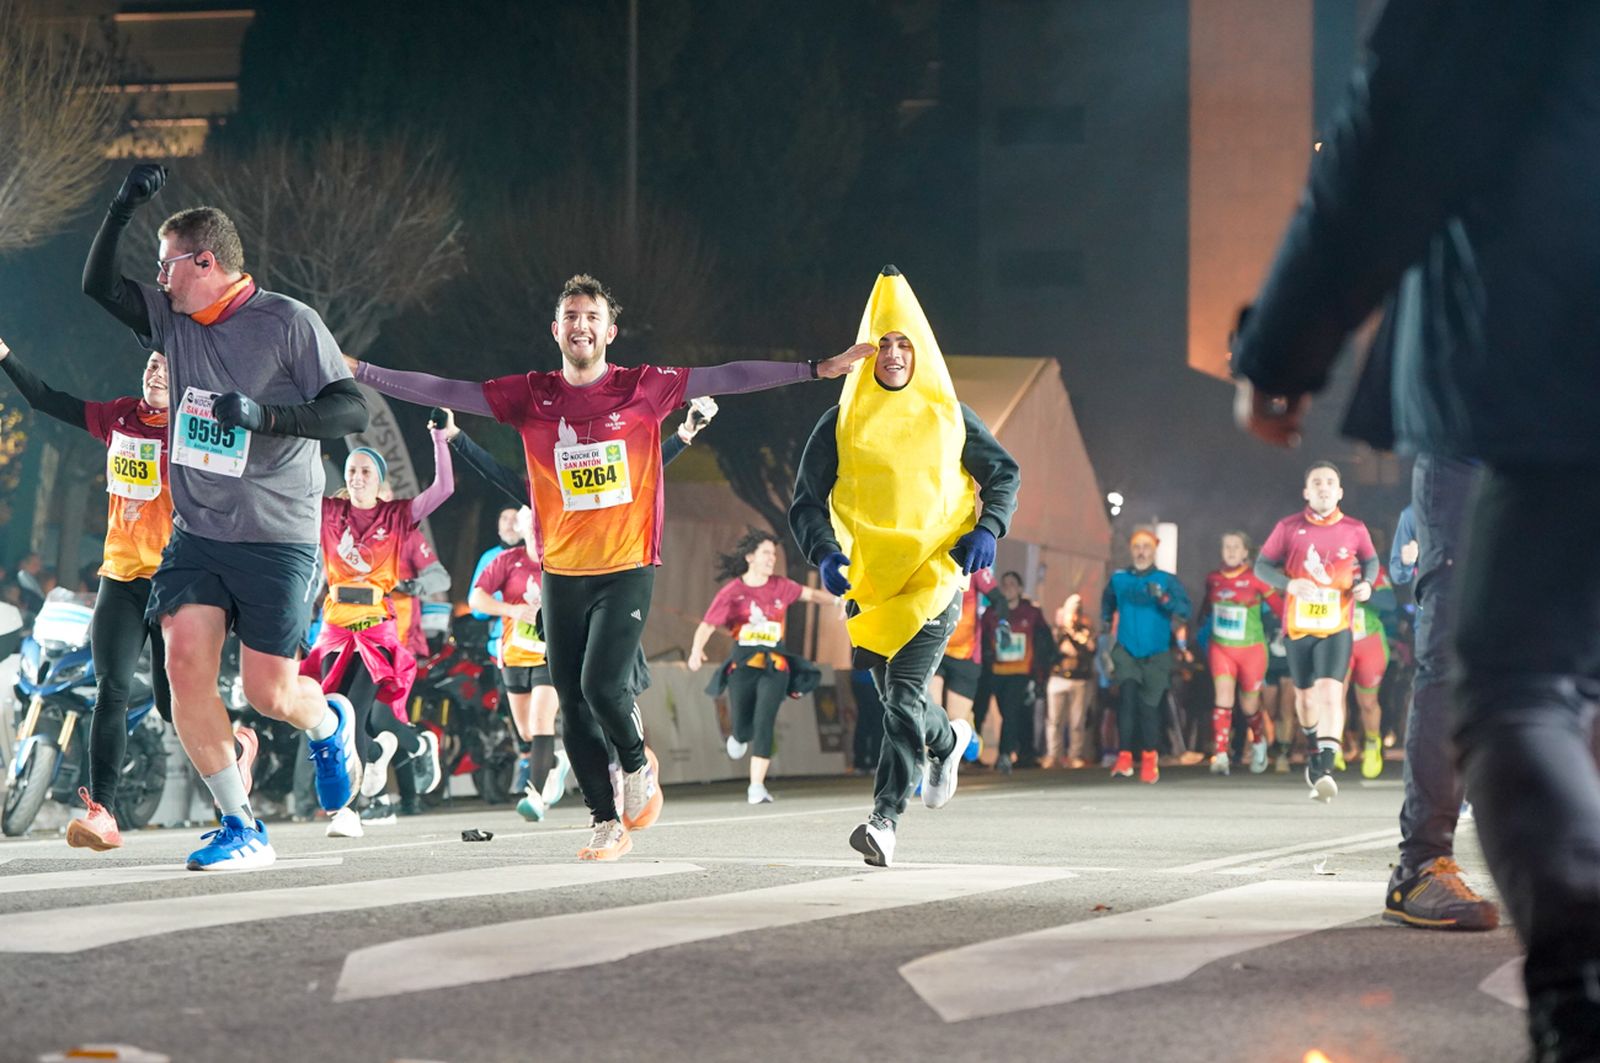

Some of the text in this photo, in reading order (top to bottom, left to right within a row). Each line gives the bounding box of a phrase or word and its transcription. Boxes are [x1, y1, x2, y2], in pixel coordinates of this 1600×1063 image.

[194, 398, 213, 408] NOCH
[188, 417, 235, 448] 9595
[570, 452, 590, 460] NOCHE
[578, 458, 601, 467] ANTÓN
[114, 456, 148, 479] 5263
[571, 465, 617, 488] 5264
